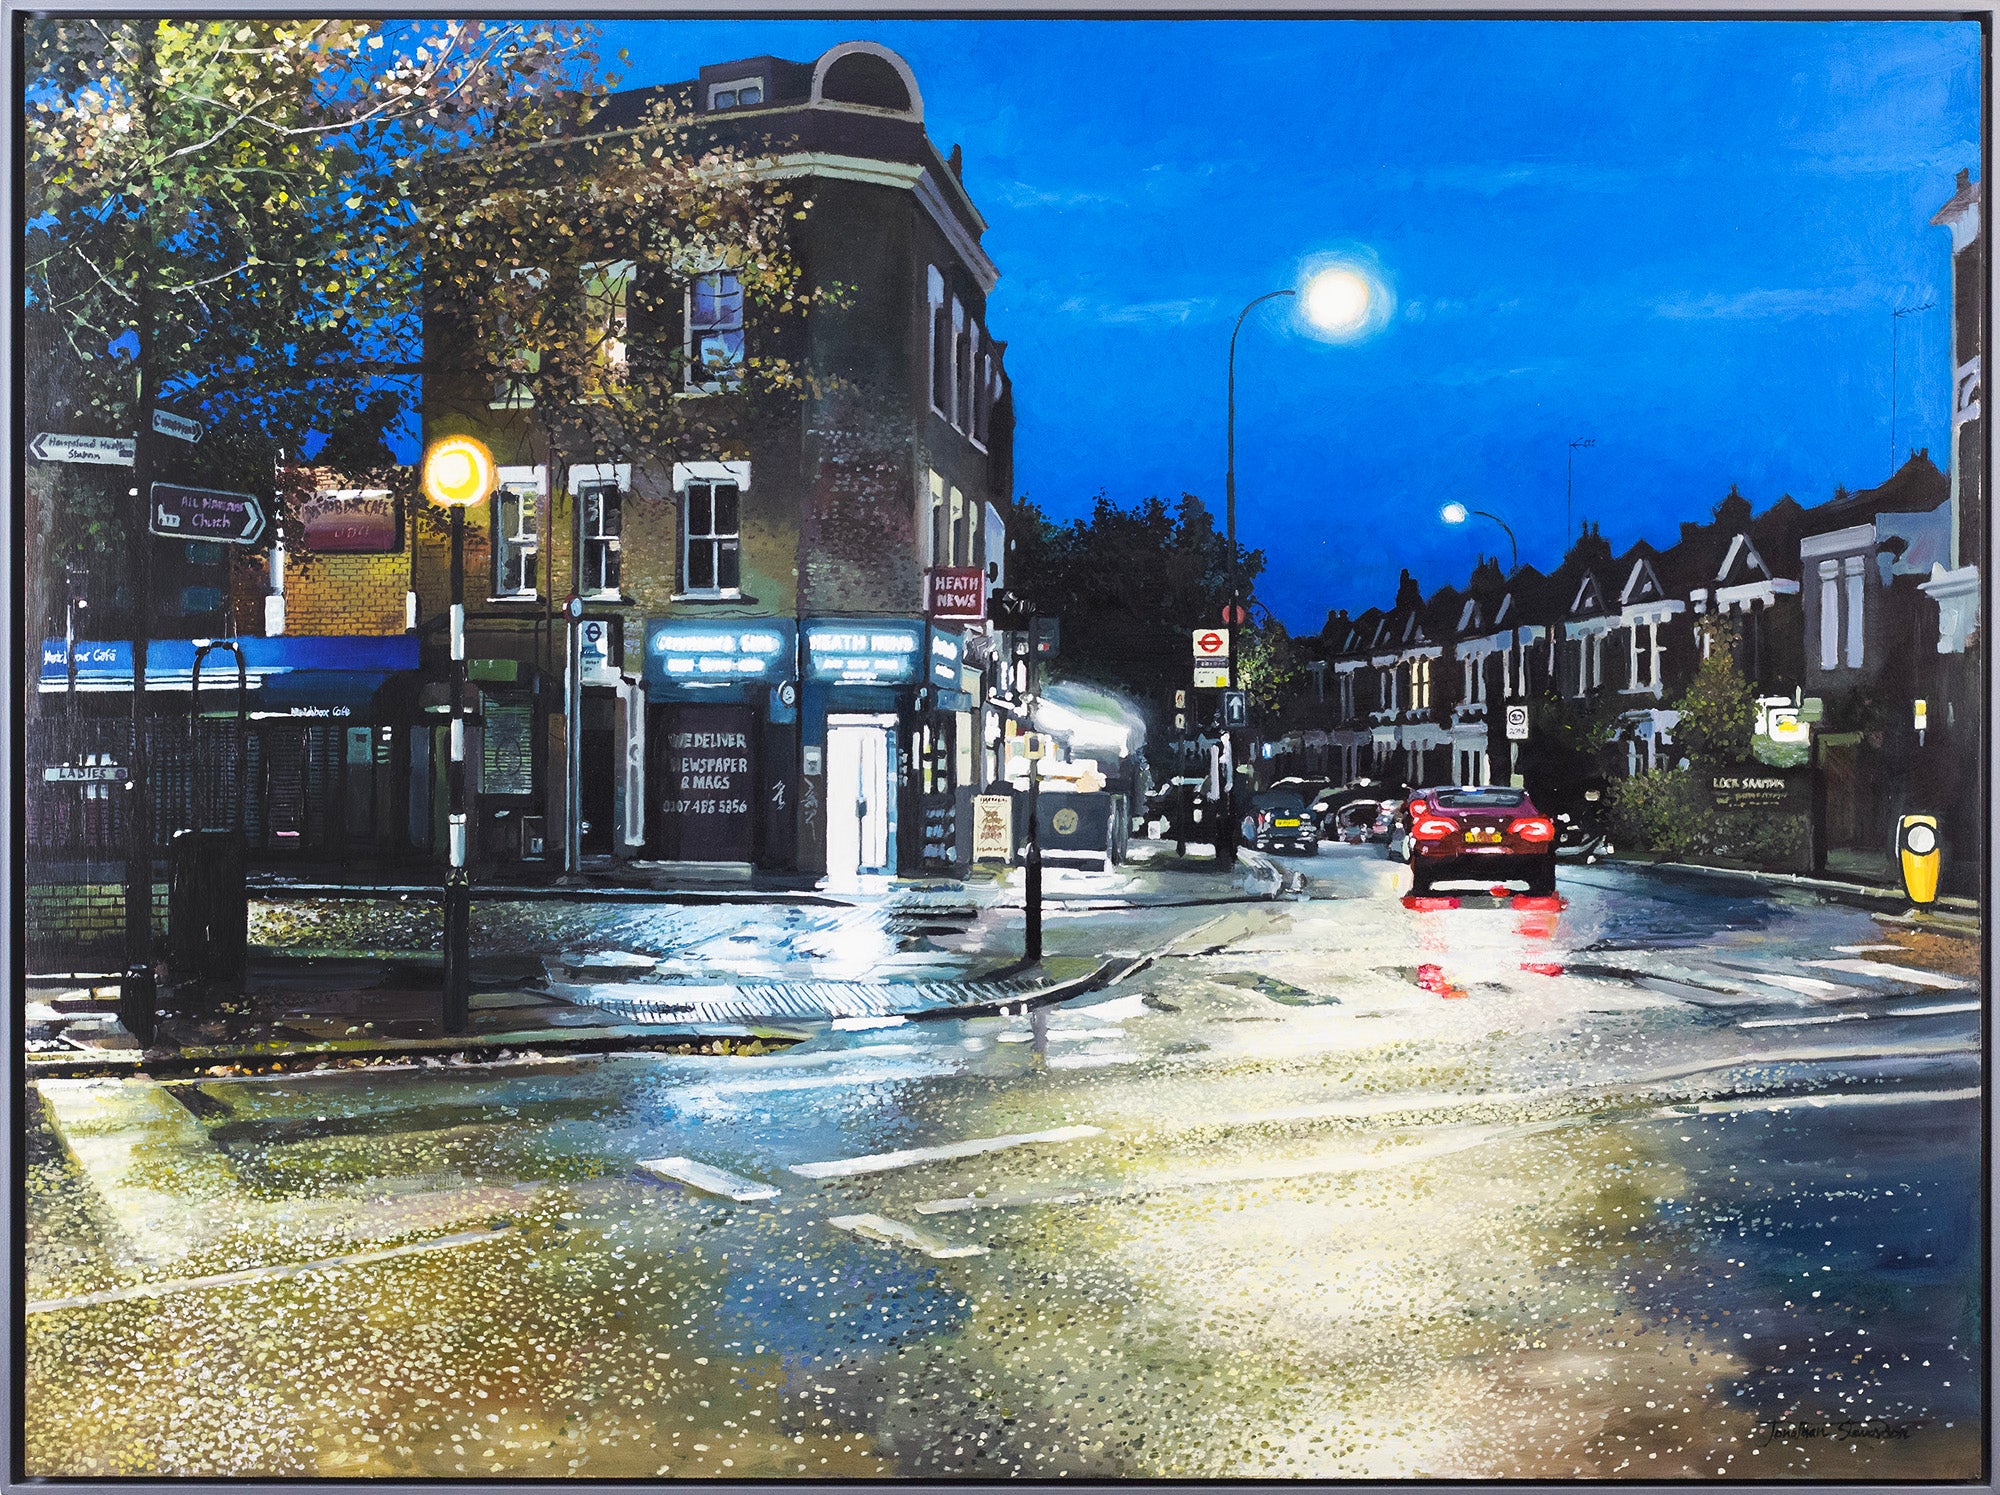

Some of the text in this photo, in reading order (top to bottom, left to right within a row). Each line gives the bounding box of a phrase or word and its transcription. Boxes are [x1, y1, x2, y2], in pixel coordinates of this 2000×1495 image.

[191, 513, 231, 529] Church
[935, 576, 979, 591] HEATH
[936, 593, 977, 608] NEWS
[668, 732, 747, 749] WE DELIVER
[59, 768, 107, 779] LADIES
[692, 774, 730, 789] MAGS
